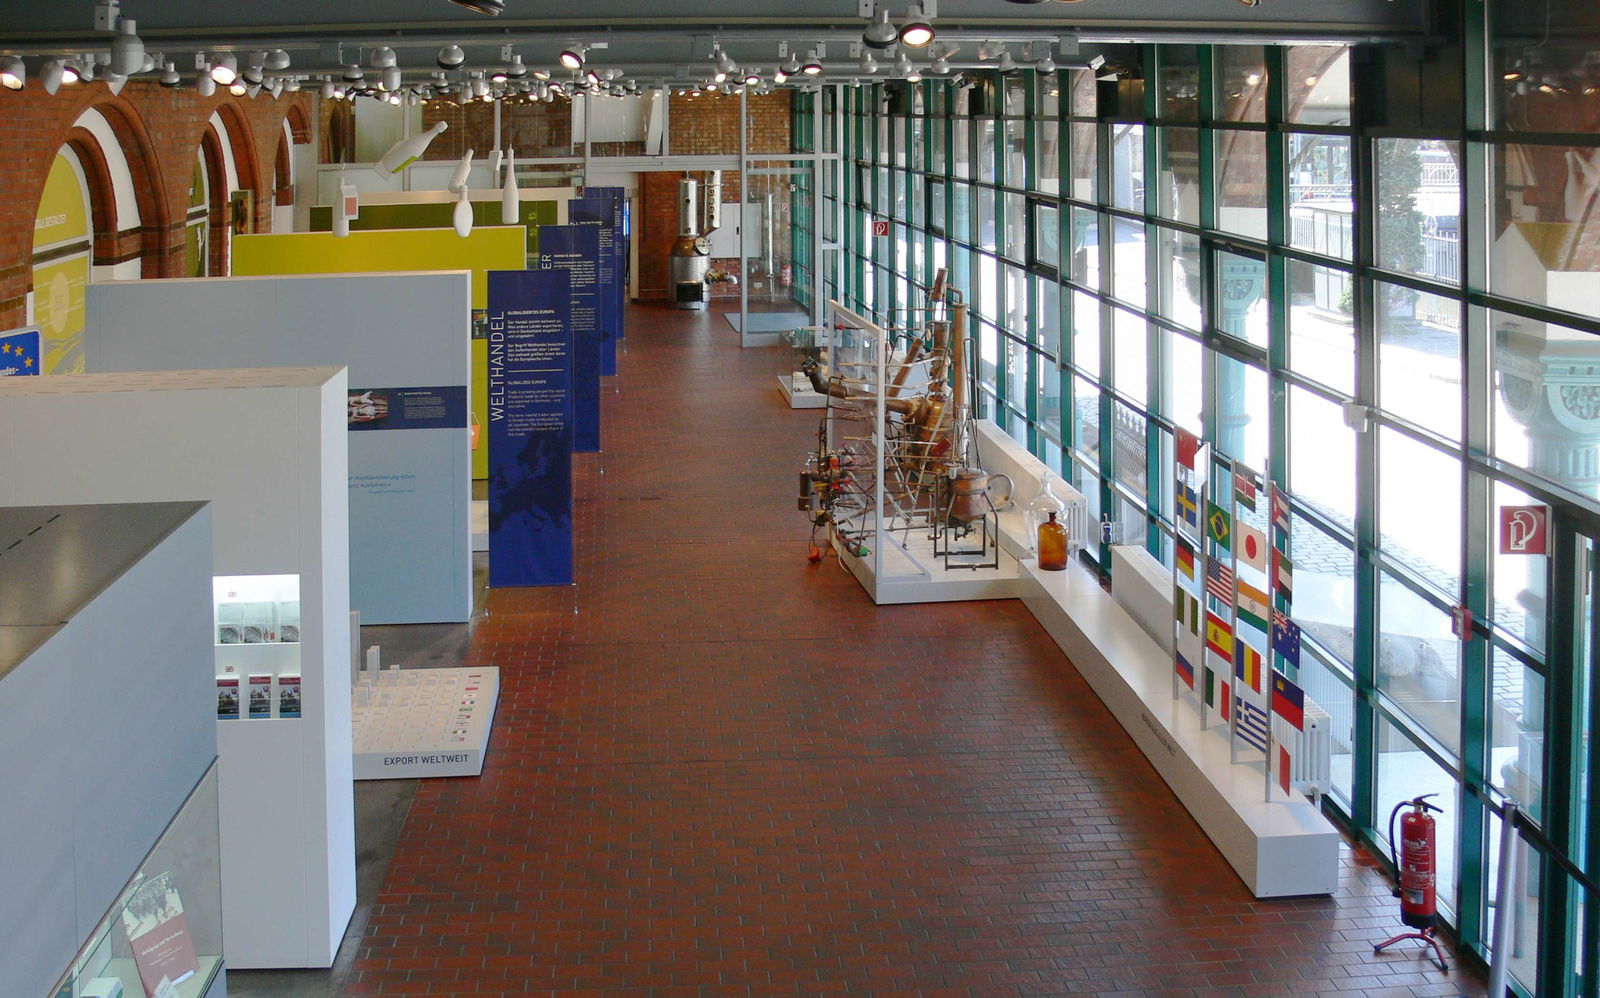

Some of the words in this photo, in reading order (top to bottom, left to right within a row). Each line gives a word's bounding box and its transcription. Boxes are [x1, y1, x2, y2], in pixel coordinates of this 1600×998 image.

[491, 311, 505, 422] WELTHANDEL
[384, 756, 418, 765] EXPORT
[421, 754, 469, 763] WELTWEIT
